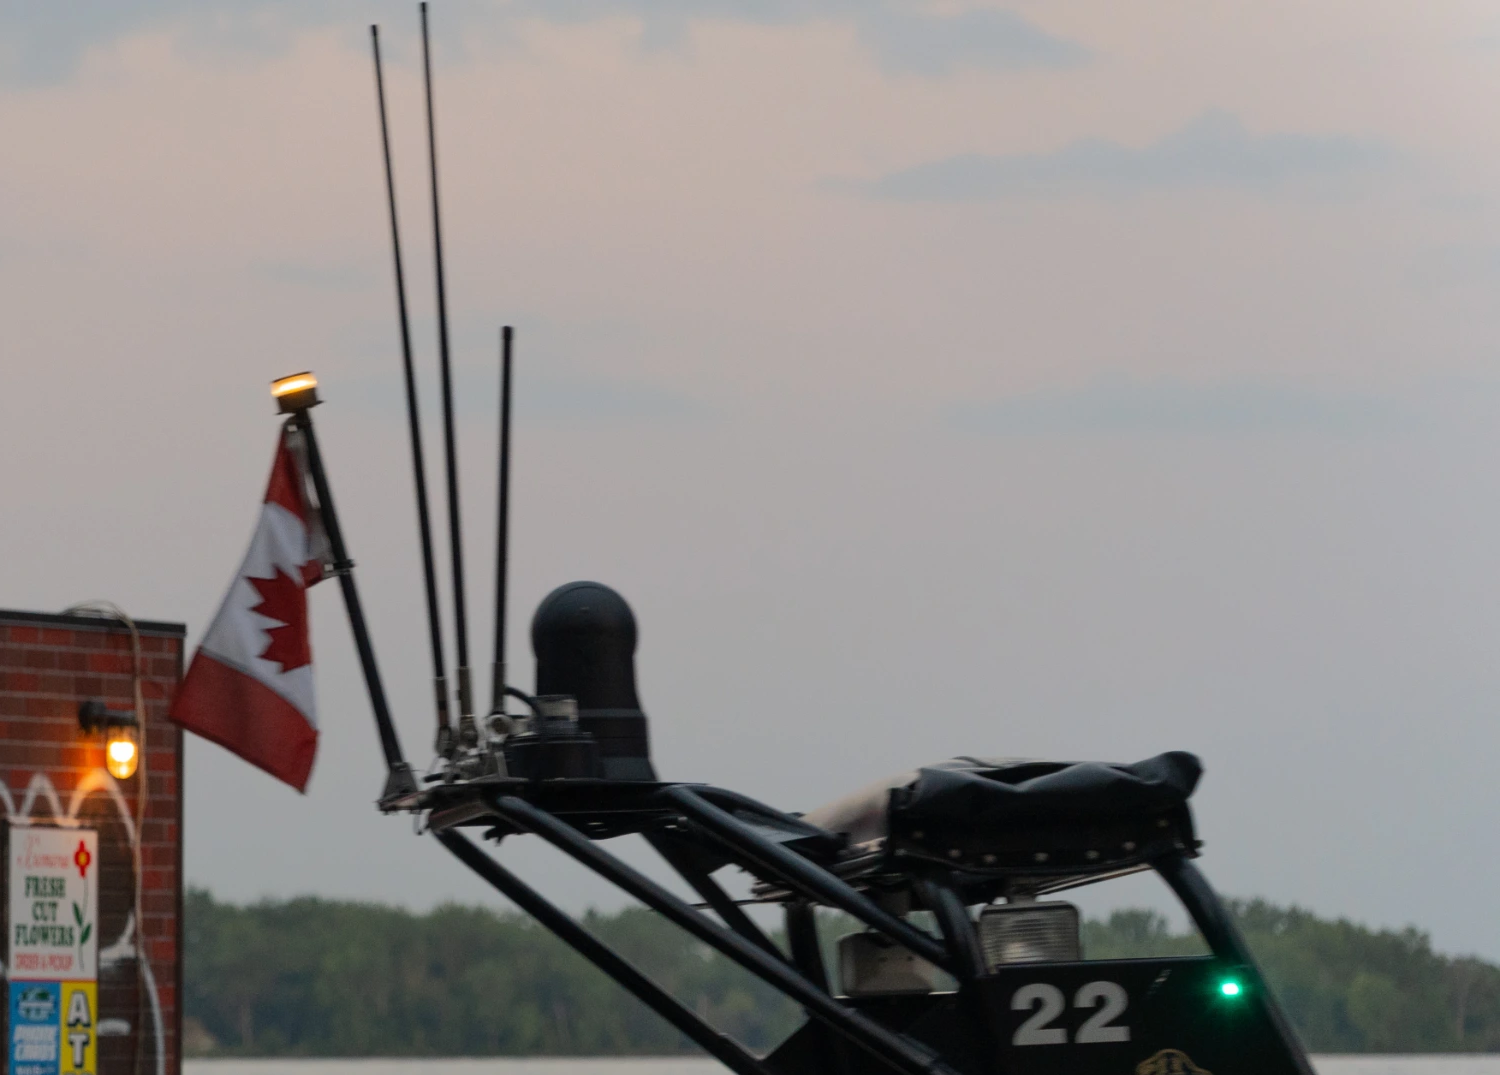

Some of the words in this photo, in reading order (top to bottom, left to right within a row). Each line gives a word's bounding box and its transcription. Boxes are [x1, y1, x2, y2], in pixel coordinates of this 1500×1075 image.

[25, 876, 66, 898] FRESH
[32, 901, 58, 921] CUT
[15, 923, 75, 946] FLOWERS
[1011, 981, 1131, 1046] 22
